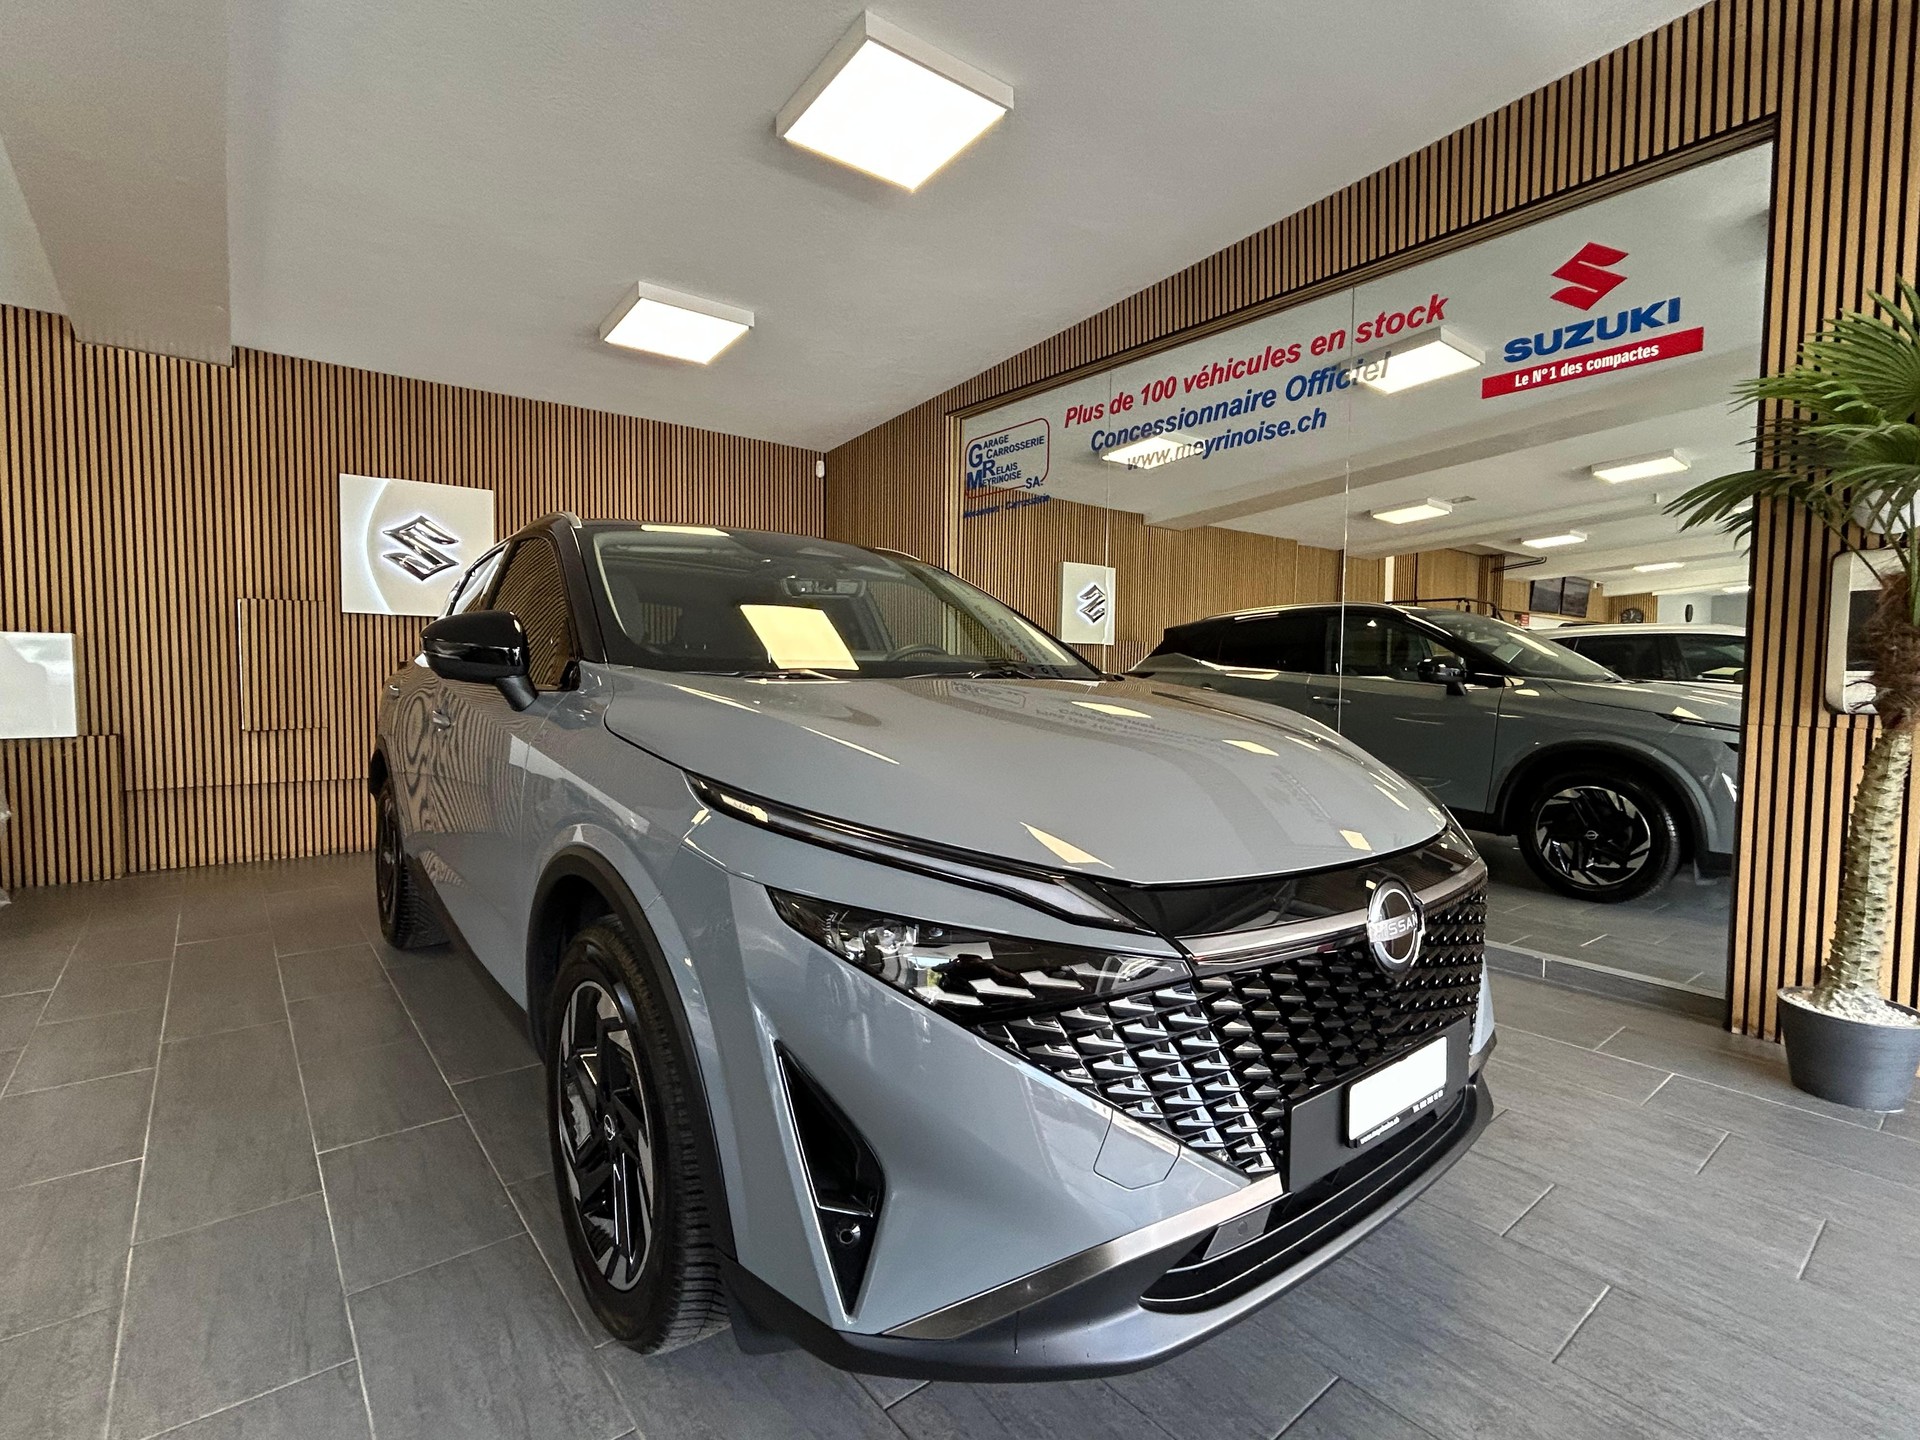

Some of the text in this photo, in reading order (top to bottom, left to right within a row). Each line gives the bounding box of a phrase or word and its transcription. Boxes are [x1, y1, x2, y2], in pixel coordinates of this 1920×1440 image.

[1503, 296, 1681, 363] SUZUKI
[1064, 294, 1449, 428] Plus de 100 véhicules en stock
[1514, 374, 1529, 388] Le
[1560, 361, 1583, 377] des
[1586, 344, 1660, 372] compactes
[1090, 350, 1392, 451] Concessionnaire Officiel
[986, 435, 1045, 460] CARROSSERIE
[1127, 407, 1327, 470] www.meyrinoise.ch
[982, 459, 1018, 479] RELAIS
[1371, 911, 1418, 942] ISSAN
